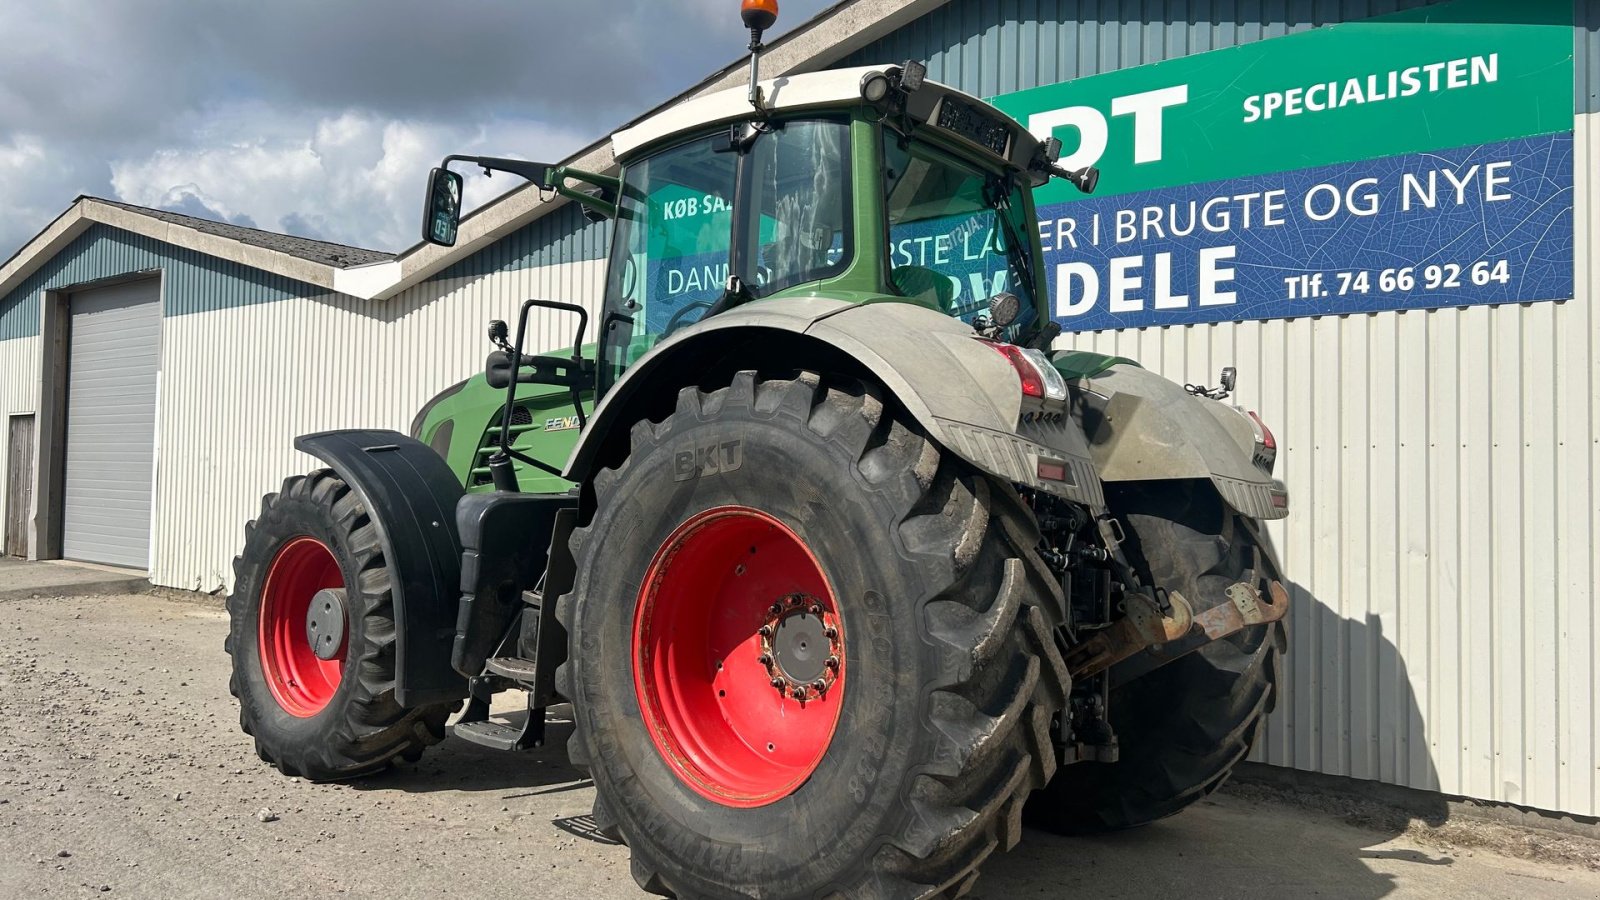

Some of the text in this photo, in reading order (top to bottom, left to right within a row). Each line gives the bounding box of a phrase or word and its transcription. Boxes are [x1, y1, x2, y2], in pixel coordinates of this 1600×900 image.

[1243, 53, 1498, 122] SPECIALISTEN
[1116, 189, 1286, 244] BRUGTE
[1304, 177, 1379, 221] OG
[1402, 160, 1512, 212] NYE
[1284, 259, 1511, 300] Tlf. 74 66 92 64
[674, 439, 743, 480] BKT
